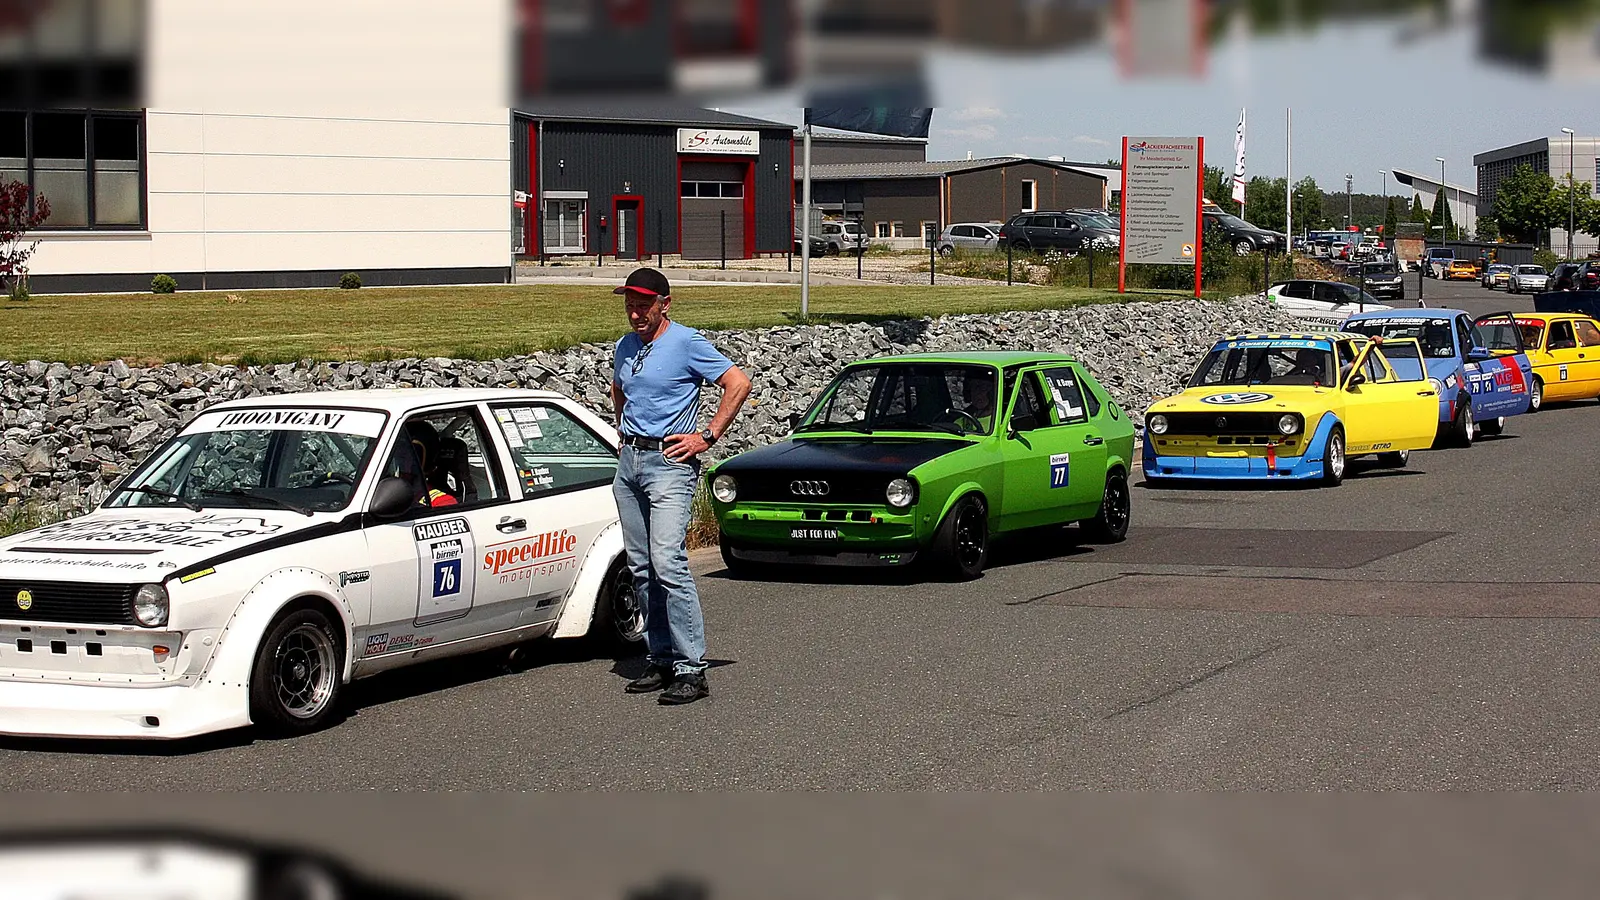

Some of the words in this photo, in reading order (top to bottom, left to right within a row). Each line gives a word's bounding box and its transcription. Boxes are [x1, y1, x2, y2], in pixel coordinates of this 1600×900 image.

[711, 134, 752, 146] Automobile
[1054, 466, 1066, 485] 77
[415, 520, 468, 541] HAUBER
[790, 528, 808, 540] JUST
[809, 528, 823, 540] FOR
[824, 529, 837, 540] FUN
[435, 549, 460, 560] birner
[483, 528, 577, 575] speedlife
[499, 558, 577, 584] motorsport
[439, 565, 455, 592] 76
[368, 633, 388, 645] LIQUI
[389, 634, 415, 646] DENSO
[365, 643, 386, 655] MOLY
